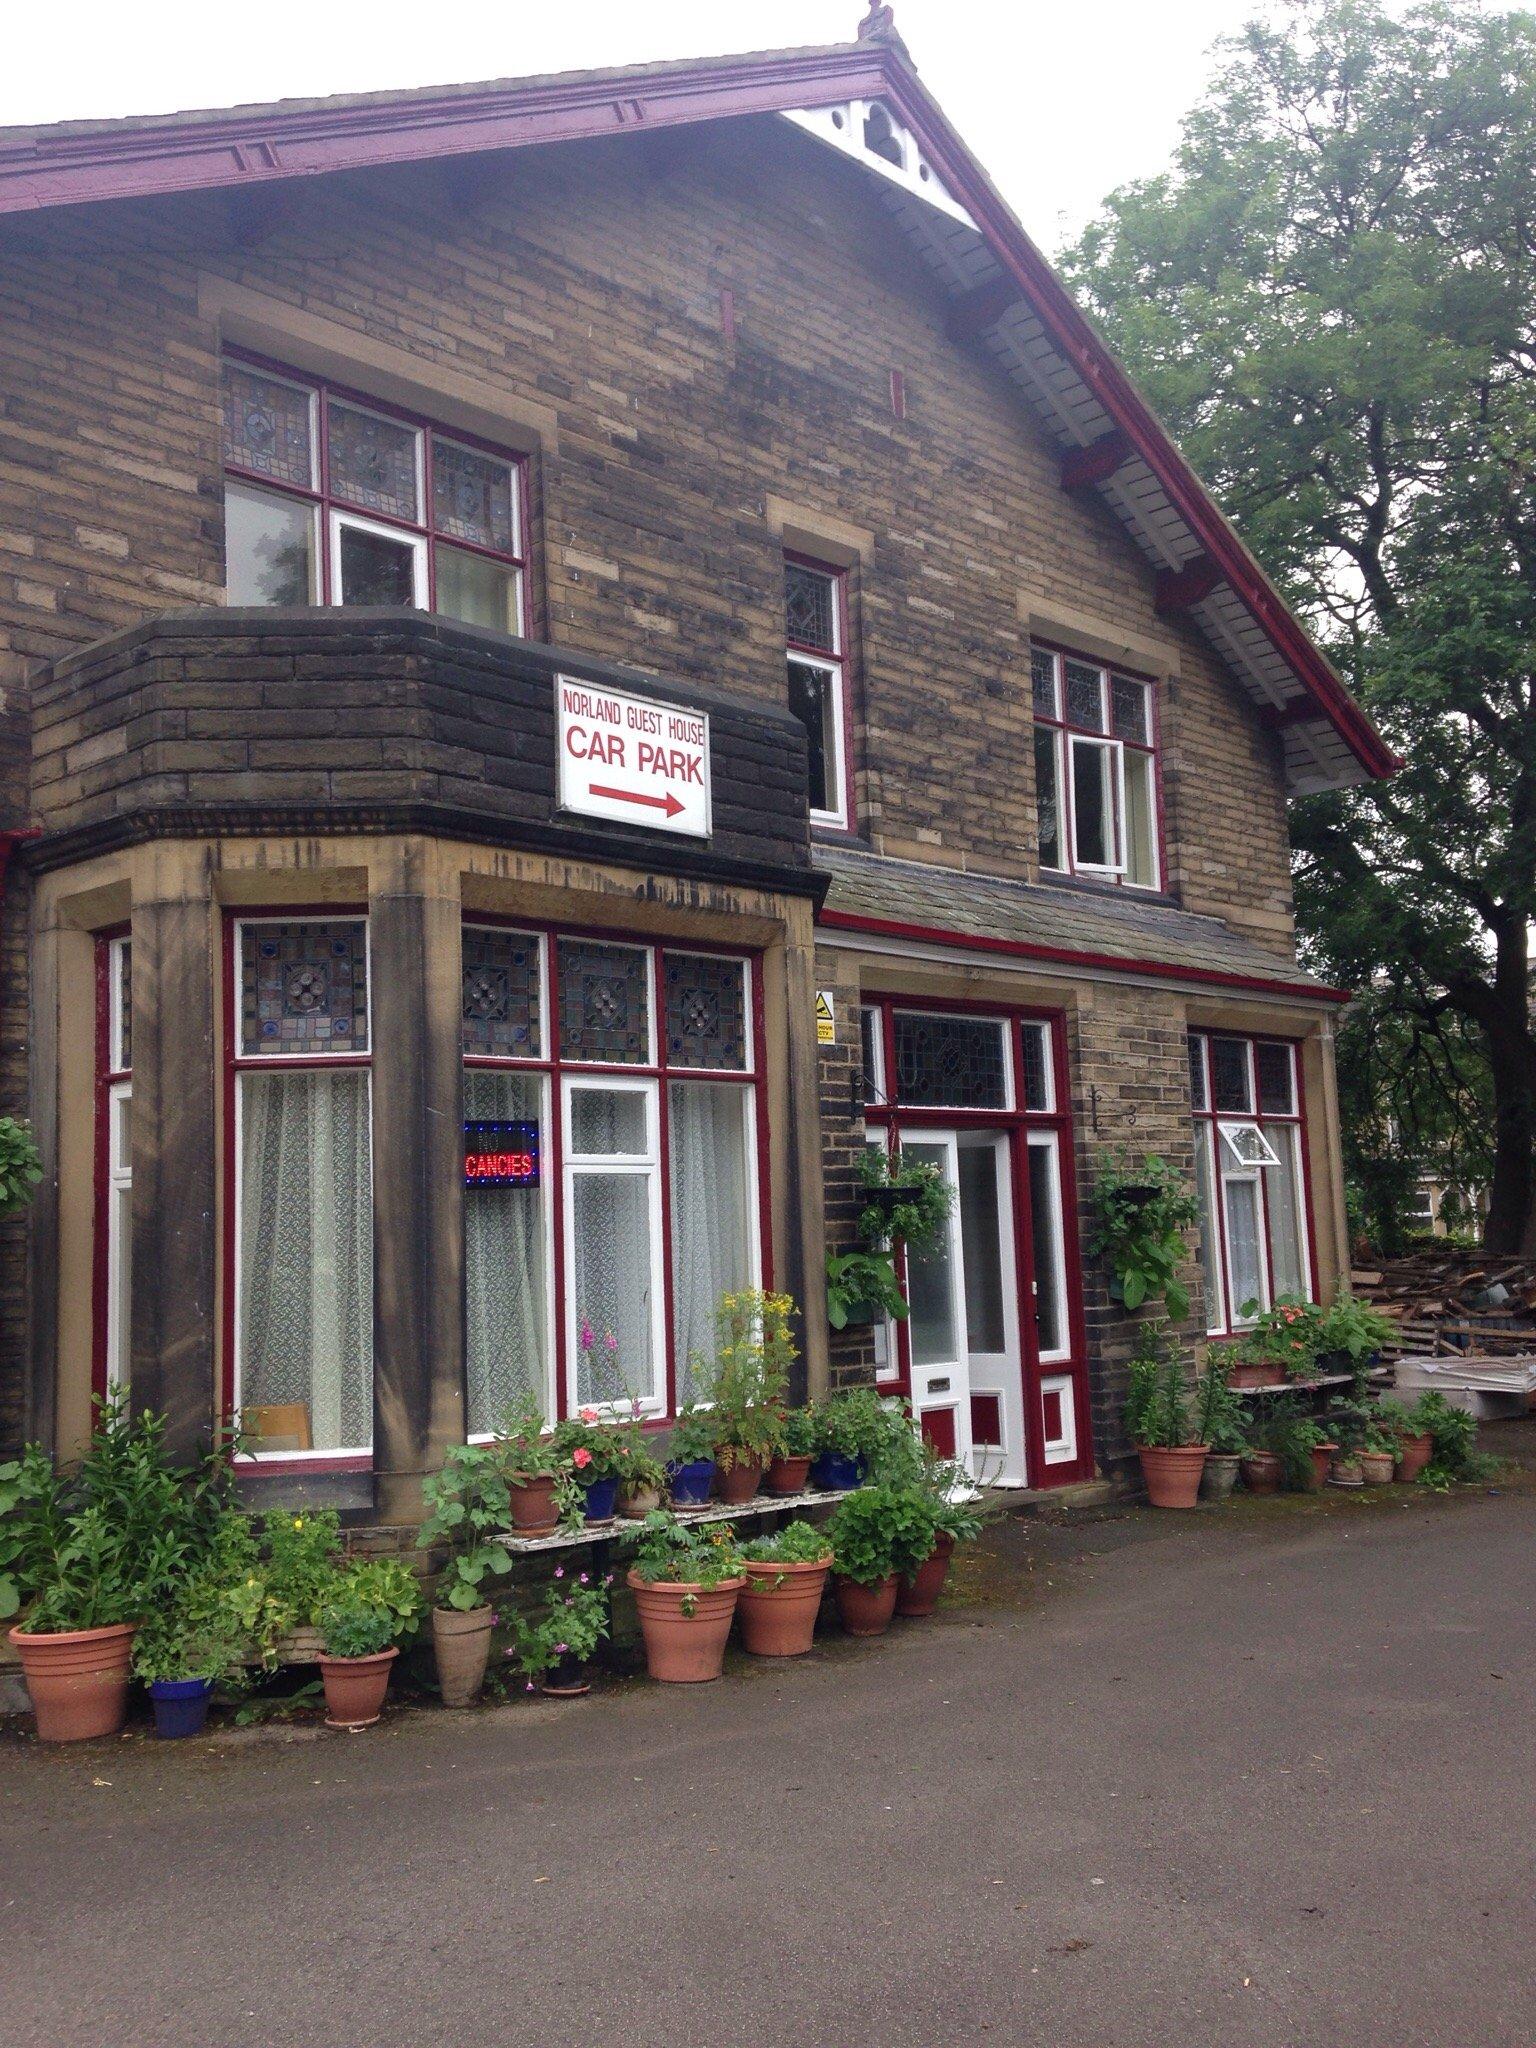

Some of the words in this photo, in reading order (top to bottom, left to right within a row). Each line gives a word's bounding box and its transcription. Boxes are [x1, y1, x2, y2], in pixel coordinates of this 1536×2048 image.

[563, 689, 621, 725] NORLAND
[627, 706, 662, 735] GUEST
[669, 716, 704, 746] HOUSE
[566, 725, 626, 768] CAR
[638, 741, 704, 786] PARK
